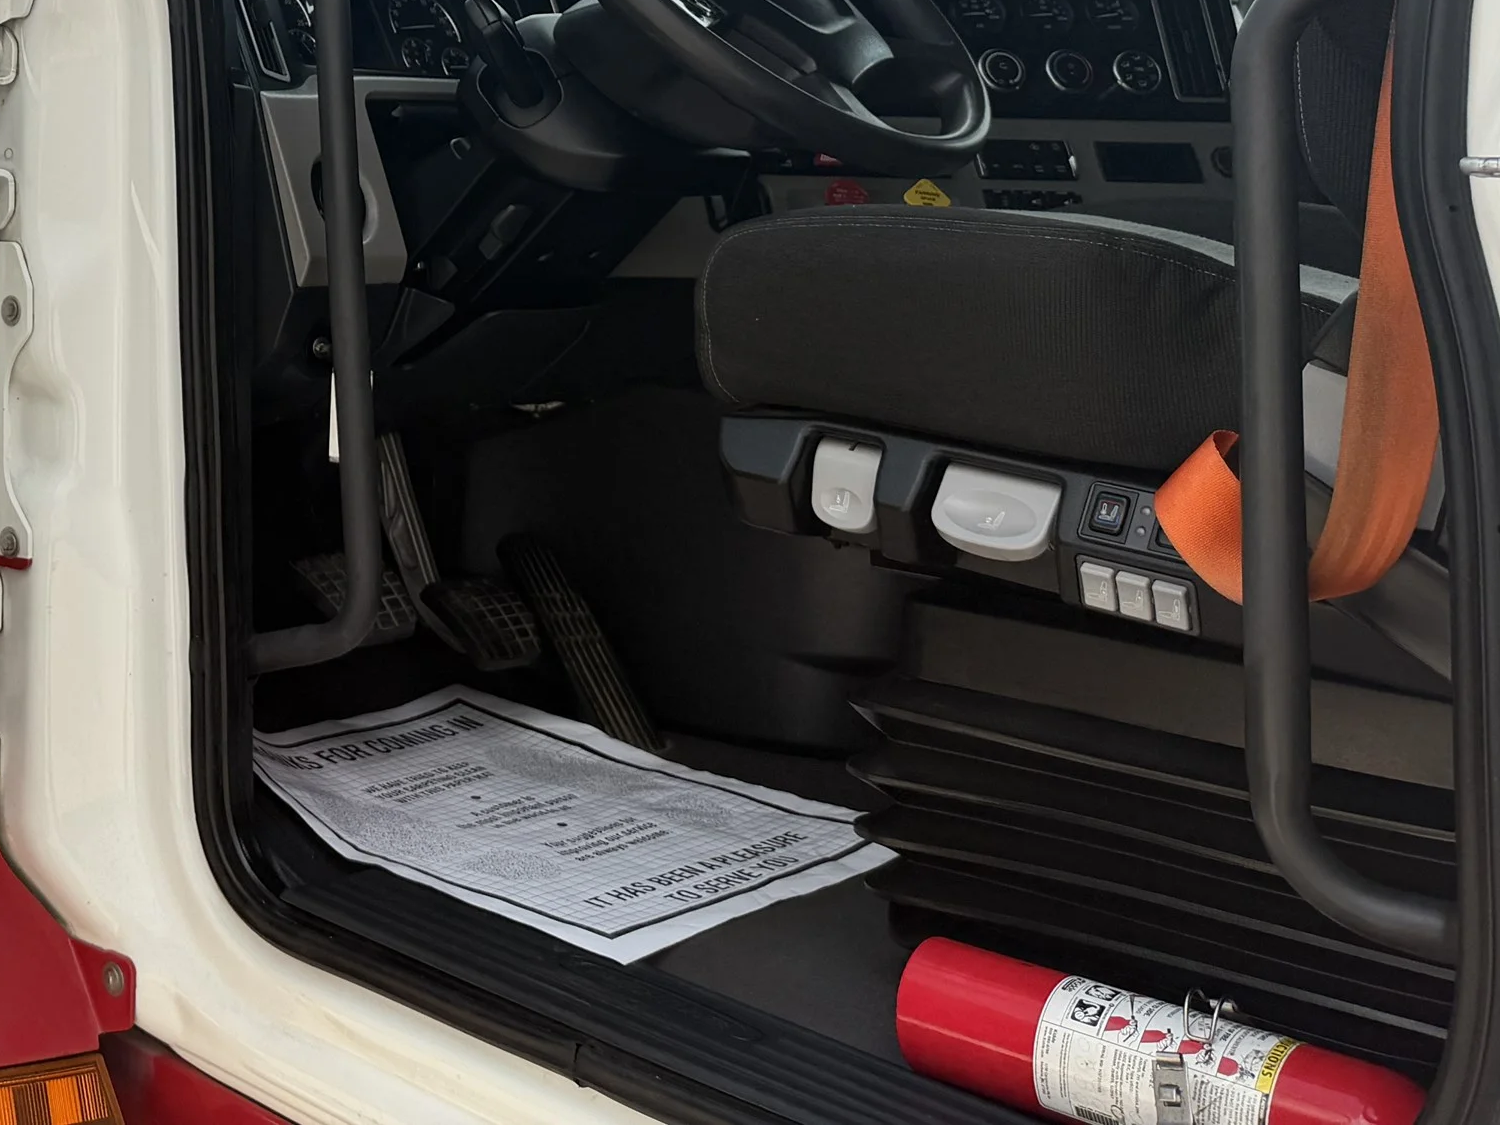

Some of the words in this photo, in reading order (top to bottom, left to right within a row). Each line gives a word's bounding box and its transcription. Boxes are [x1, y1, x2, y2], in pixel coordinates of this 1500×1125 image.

[316, 742, 373, 764] FOR
[363, 719, 460, 754] COMING
[451, 714, 485, 731] IN
[583, 895, 614, 909] IT
[605, 881, 657, 902] HAS
[649, 864, 707, 887] BEEN
[698, 859, 718, 871] A
[710, 830, 809, 866] PLEASURE
[663, 888, 704, 903] TO
[694, 868, 763, 895] SERVE
[751, 854, 800, 872] YOU
